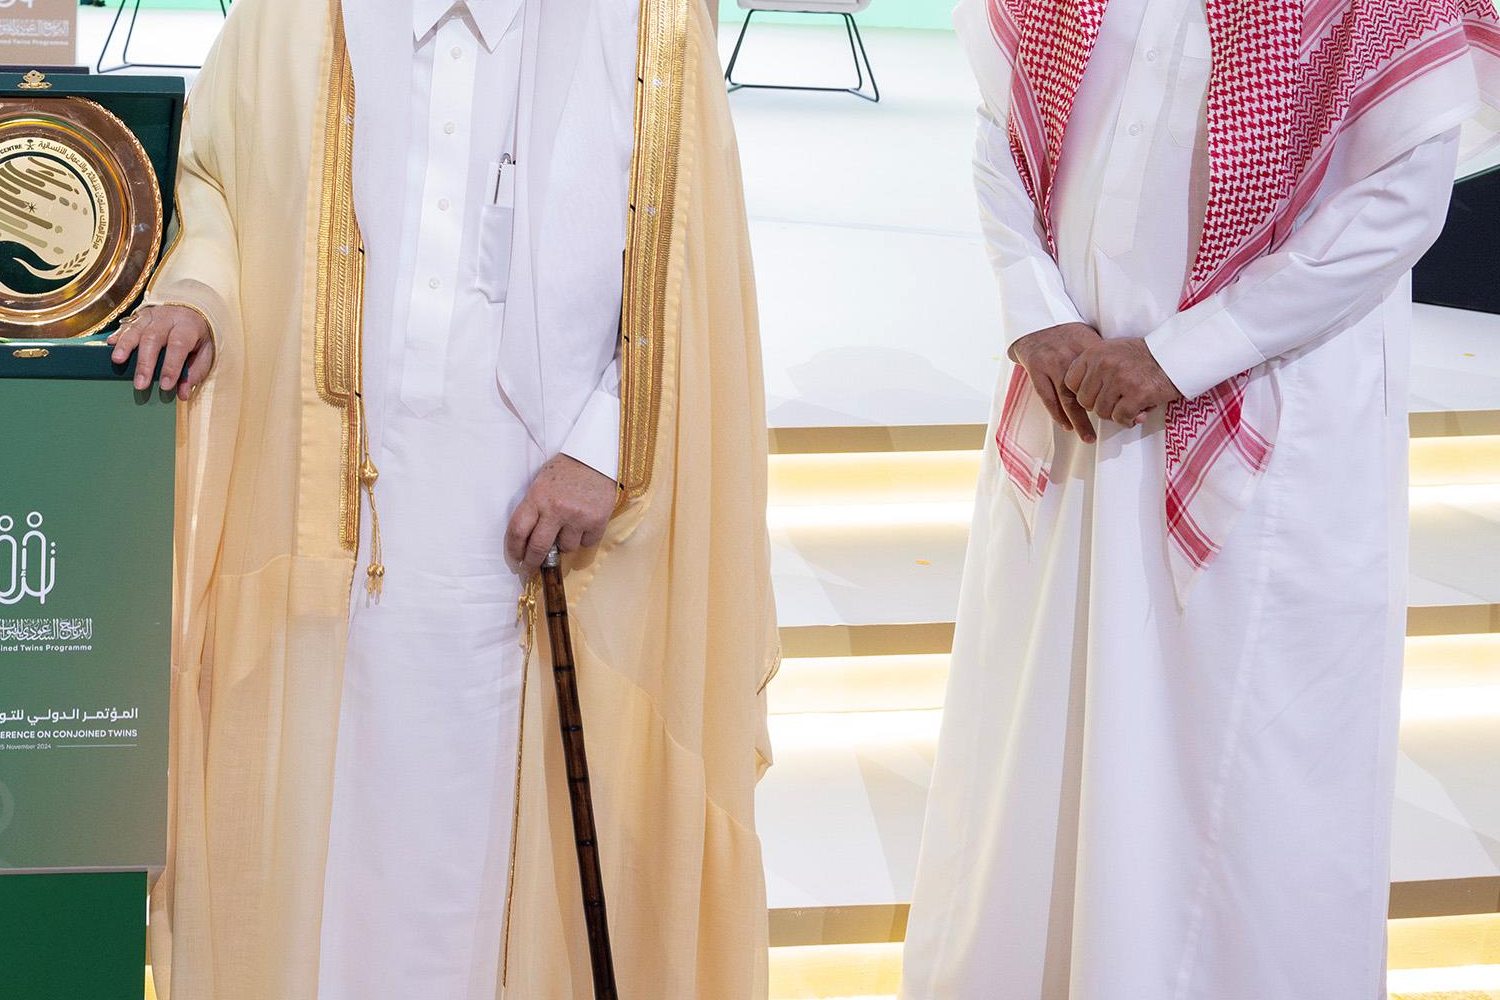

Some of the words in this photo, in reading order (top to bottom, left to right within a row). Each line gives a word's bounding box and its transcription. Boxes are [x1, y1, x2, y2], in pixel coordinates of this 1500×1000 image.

[0, 144, 22, 155] CENTRE
[46, 645, 92, 653] Programme
[27, 708, 80, 726] الدولي
[82, 707, 139, 723] المؤتمر
[37, 730, 51, 739] ON
[52, 730, 107, 738] CONJOINED
[108, 729, 138, 738] TWINS
